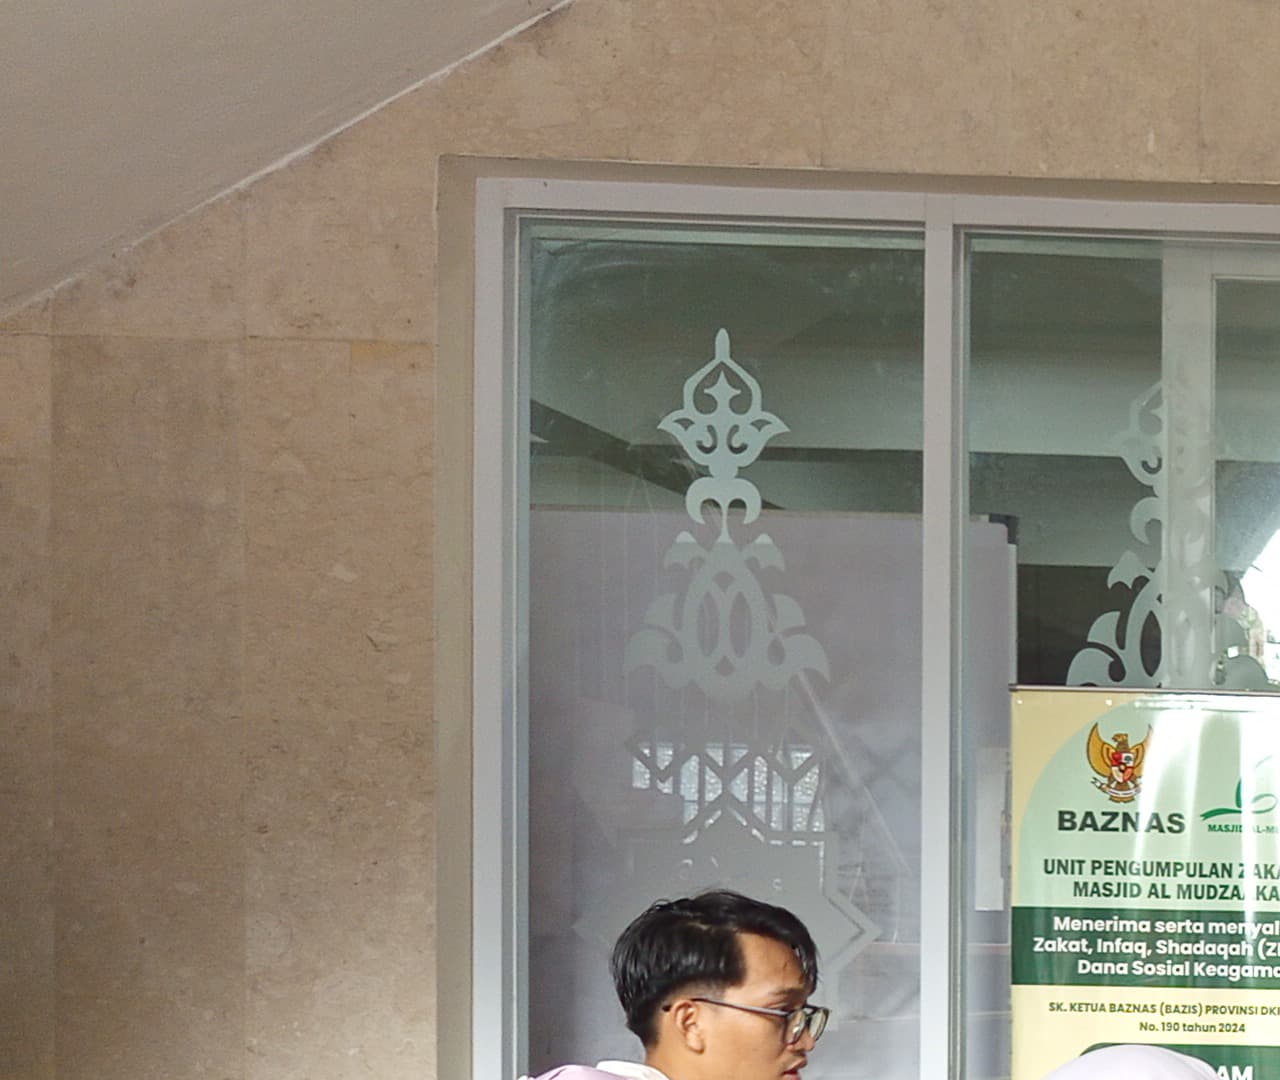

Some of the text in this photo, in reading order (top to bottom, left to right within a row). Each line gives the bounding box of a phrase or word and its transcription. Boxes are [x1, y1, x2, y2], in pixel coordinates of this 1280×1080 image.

[1057, 810, 1185, 834] BAZNAS
[1043, 858, 1086, 875] UNIT
[1091, 859, 1233, 879] PENGUMPULAN
[1073, 881, 1142, 897] MASJID
[1147, 882, 1171, 899] AL
[1053, 916, 1151, 932] Menerima
[1154, 921, 1204, 934] serta
[1033, 937, 1093, 955] Zakat,
[1097, 938, 1152, 958] Infaq,
[1156, 939, 1253, 960] Shadaqah
[1078, 960, 1129, 974] Dana
[1132, 960, 1190, 976] Sosial
[1048, 1002, 1067, 1012] SK.
[1069, 1002, 1106, 1013] KETUA
[1109, 1003, 1157, 1014] BAZNAS
[1159, 1002, 1203, 1017] (BAZIS)
[1205, 1005, 1258, 1016] PROVINSI
[1260, 1006, 1280, 1016] DKI
[1139, 1021, 1245, 1033] No. 190 tahun 2024
